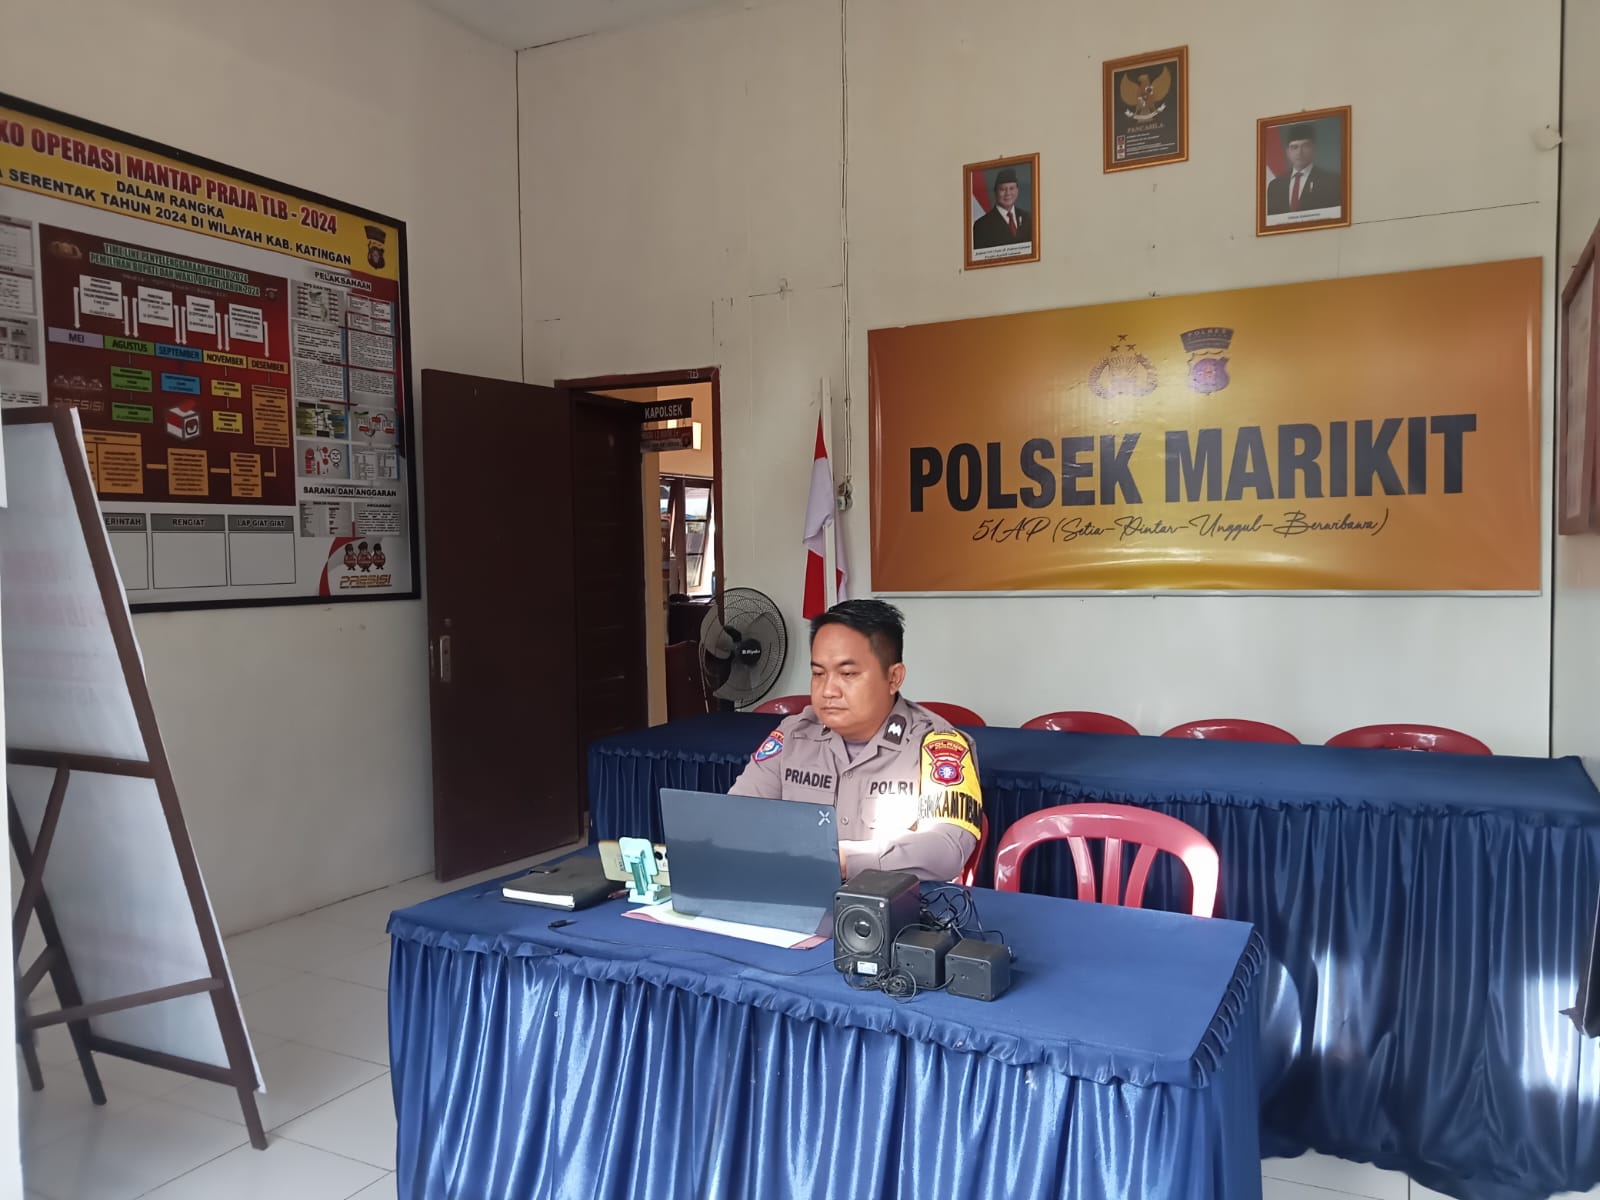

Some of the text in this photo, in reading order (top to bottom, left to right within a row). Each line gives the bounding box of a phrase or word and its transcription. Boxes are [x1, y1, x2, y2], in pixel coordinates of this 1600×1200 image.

[31, 128, 121, 175] OPERASI
[127, 155, 201, 196] MANTAP
[206, 178, 258, 212] PRAJA
[261, 194, 288, 221] TLB
[300, 206, 337, 235] 2024
[117, 180, 224, 219] DALAM RANGKA
[9, 168, 96, 201] SERENTAK
[101, 192, 151, 215] TAHUN
[155, 206, 187, 223] 2024
[191, 217, 204, 229] DI
[208, 221, 262, 243] WILAYAH
[266, 235, 293, 251] KAB.
[296, 242, 351, 265] KATINGAN
[315, 271, 371, 291] PELAKSANAAN
[69, 332, 85, 344] MEI
[112, 339, 147, 353] AGUSTUS
[158, 346, 200, 360] SEPTEMBER
[206, 351, 244, 366] NOVEMBER
[252, 359, 285, 373] DESEMBER
[644, 404, 683, 419] KAPOLSEK
[910, 413, 1477, 512] POLSEK MARIKIT
[338, 488, 353, 496] DAN
[356, 488, 396, 497] ANGGARAN
[105, 517, 141, 526] ERINTAH
[172, 518, 205, 526] RENGIAT
[785, 768, 832, 789] PRIADIE
[870, 781, 914, 796] POLRI
